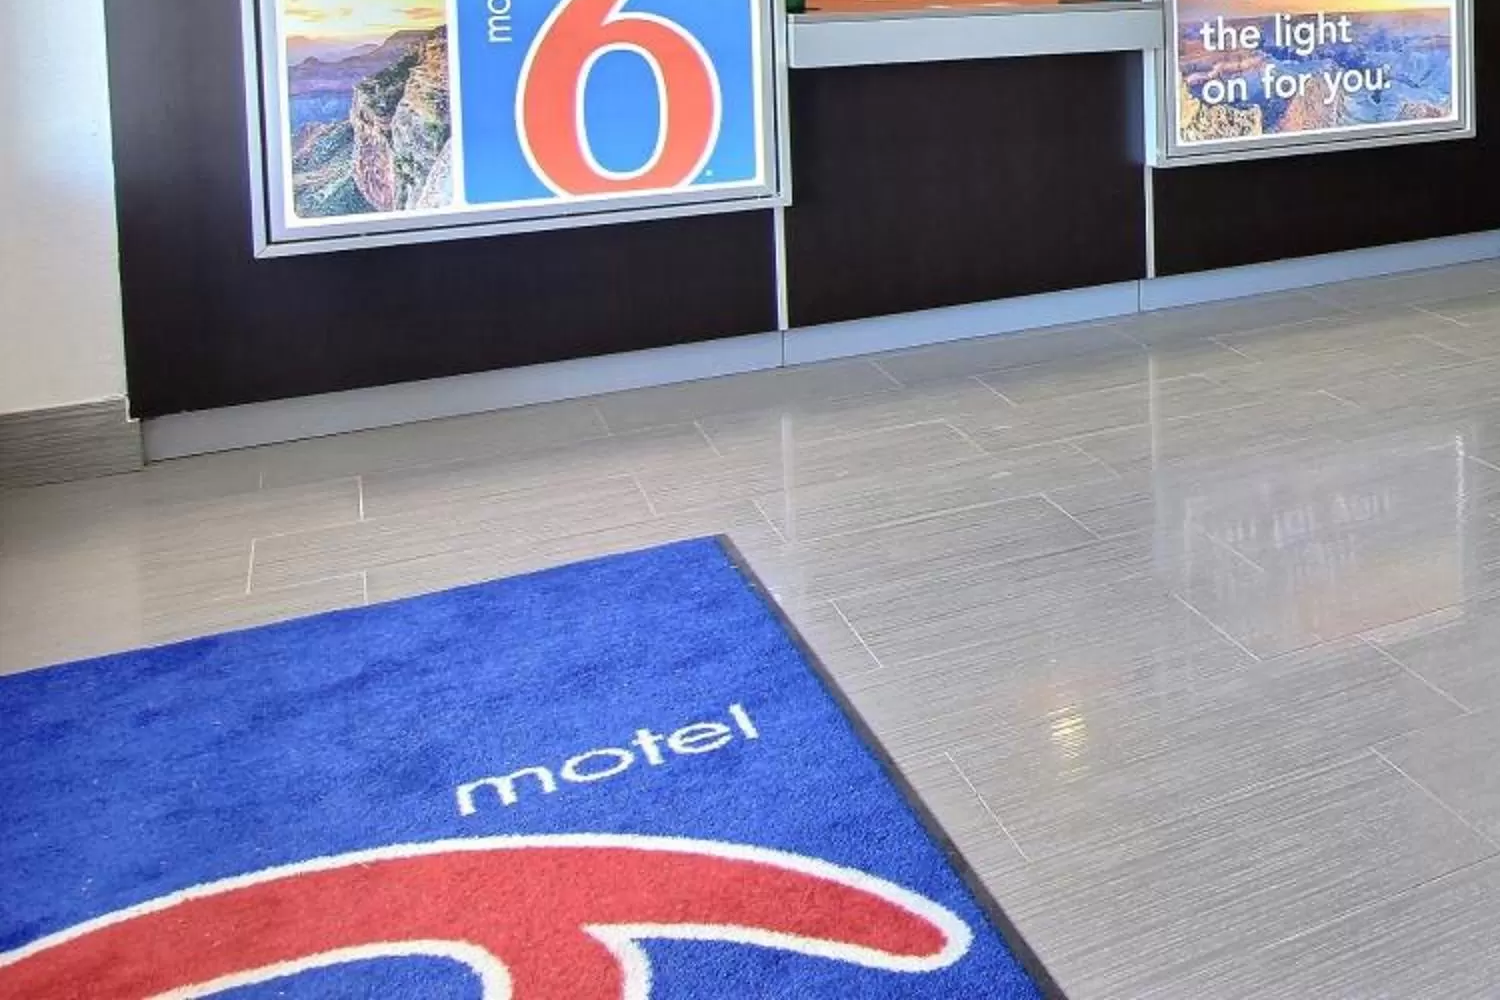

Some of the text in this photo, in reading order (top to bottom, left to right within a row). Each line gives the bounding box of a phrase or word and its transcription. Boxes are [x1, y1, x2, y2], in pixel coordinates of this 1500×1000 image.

[1199, 13, 1353, 55] the light
[1202, 75, 1248, 105] on
[1261, 66, 1310, 100] for
[455, 703, 761, 817] motel
